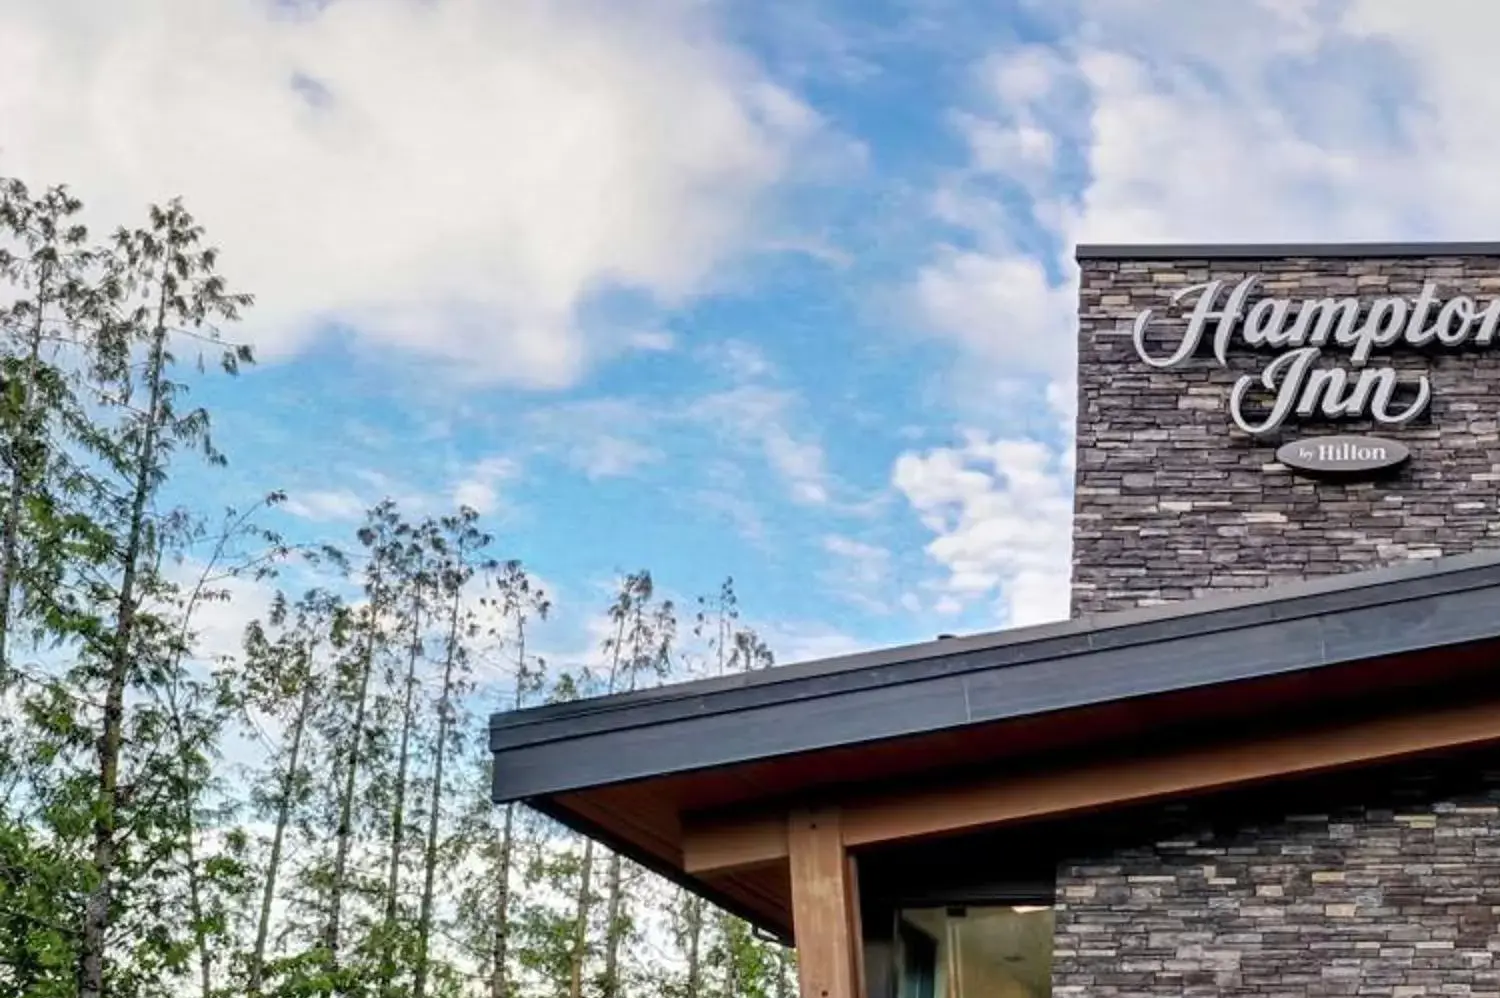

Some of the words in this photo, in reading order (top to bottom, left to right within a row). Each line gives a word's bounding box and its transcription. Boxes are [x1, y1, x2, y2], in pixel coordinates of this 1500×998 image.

[1230, 346, 1431, 434] Inn
[1299, 447, 1313, 462] by
[1319, 443, 1386, 461] Hilton
